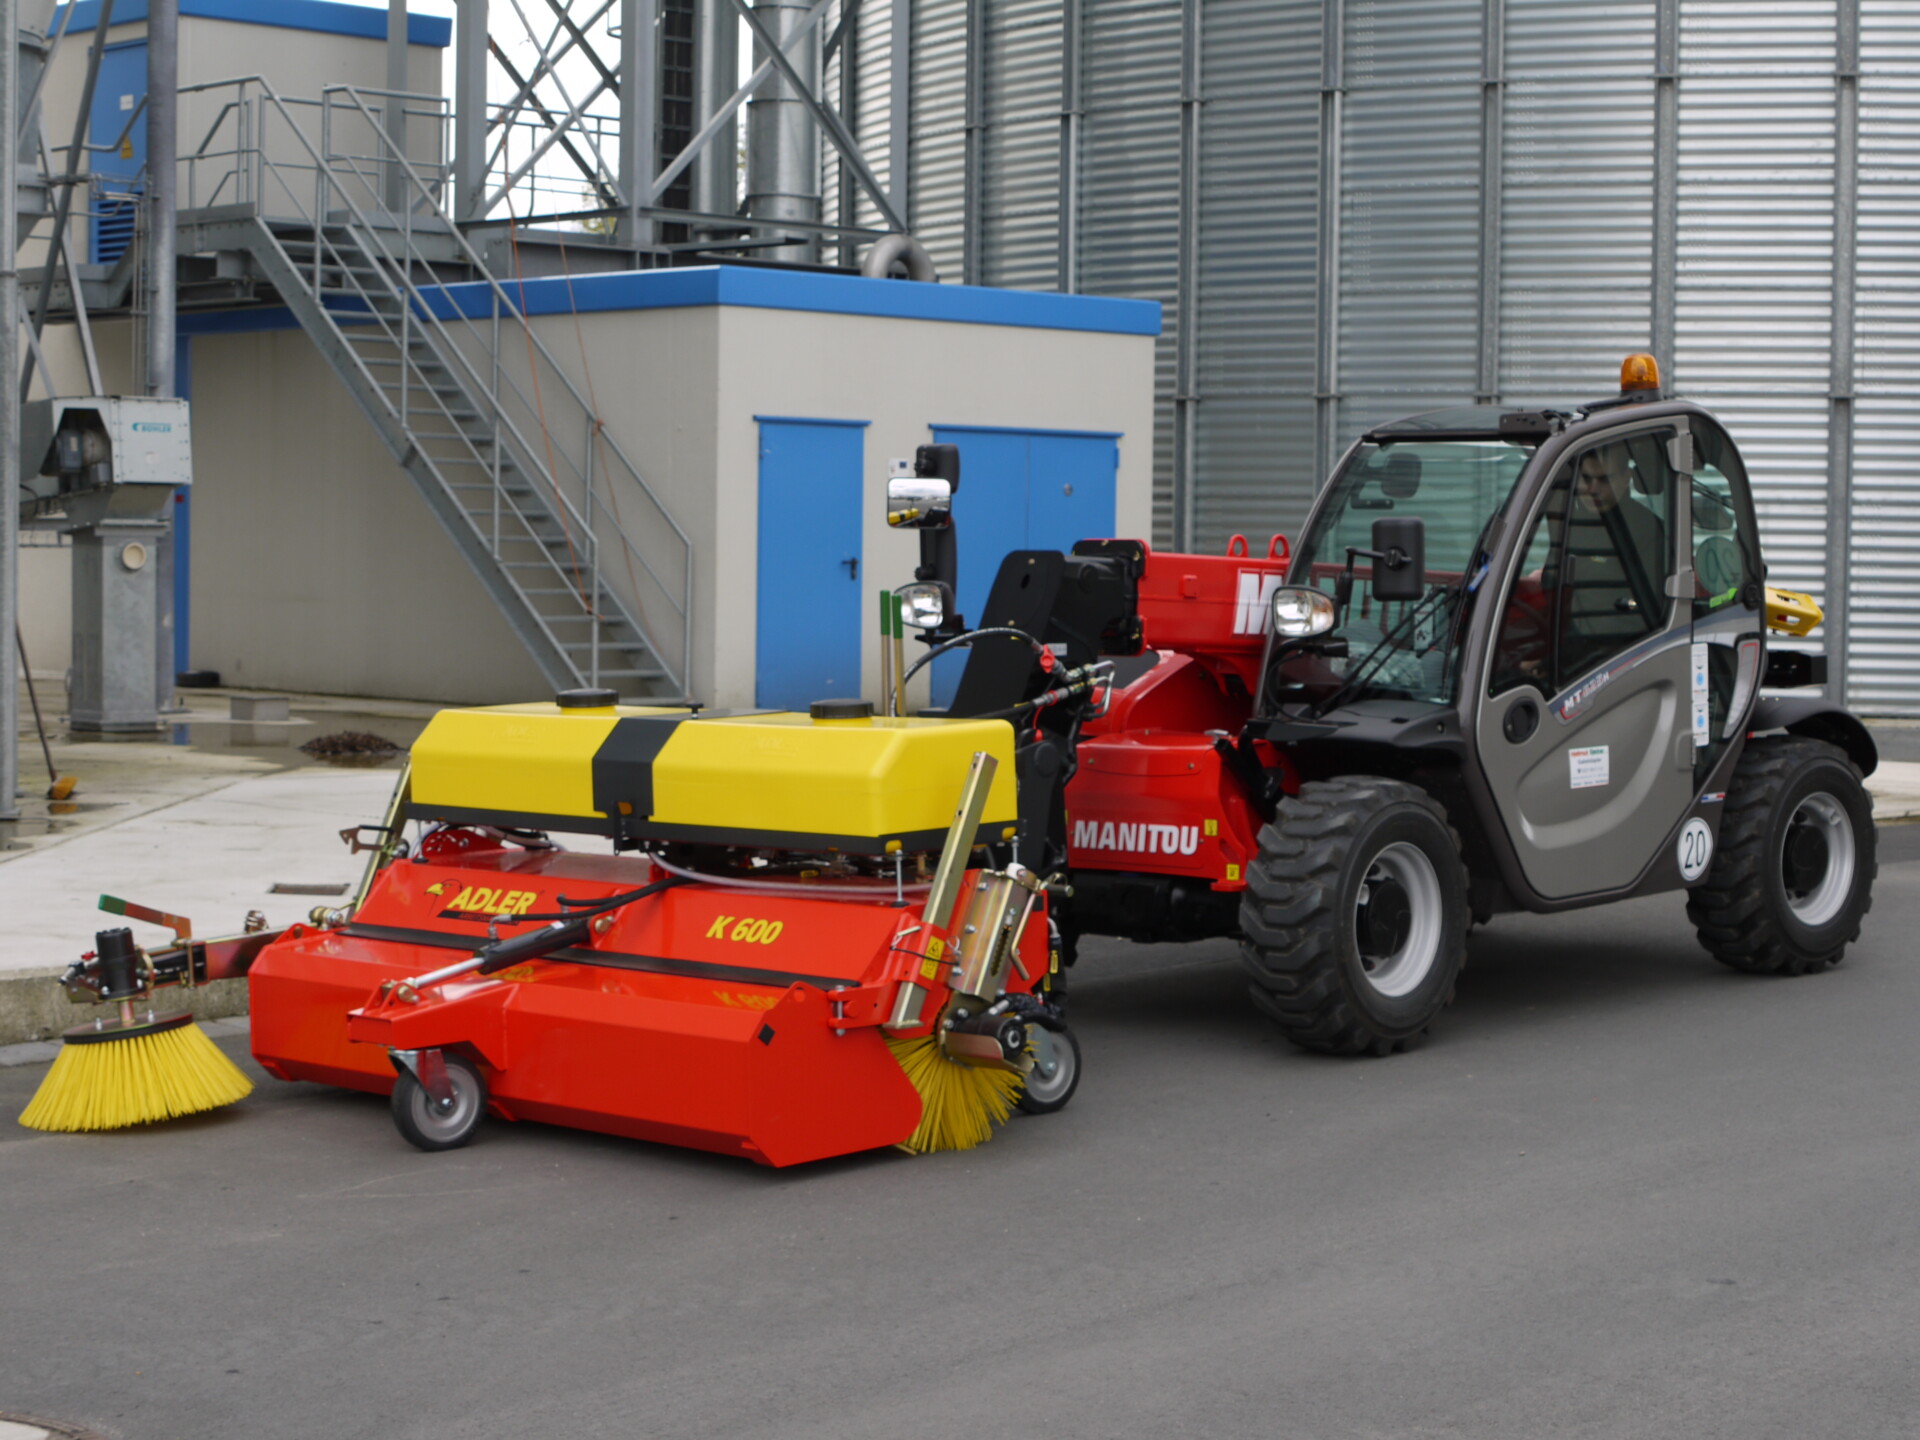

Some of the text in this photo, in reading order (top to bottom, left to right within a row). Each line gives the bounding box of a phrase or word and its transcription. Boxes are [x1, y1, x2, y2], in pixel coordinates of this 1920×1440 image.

[1073, 820, 1199, 855] MANITOU
[1684, 830, 1706, 869] 20
[446, 885, 537, 915] ADLER
[705, 915, 784, 945] K 600
